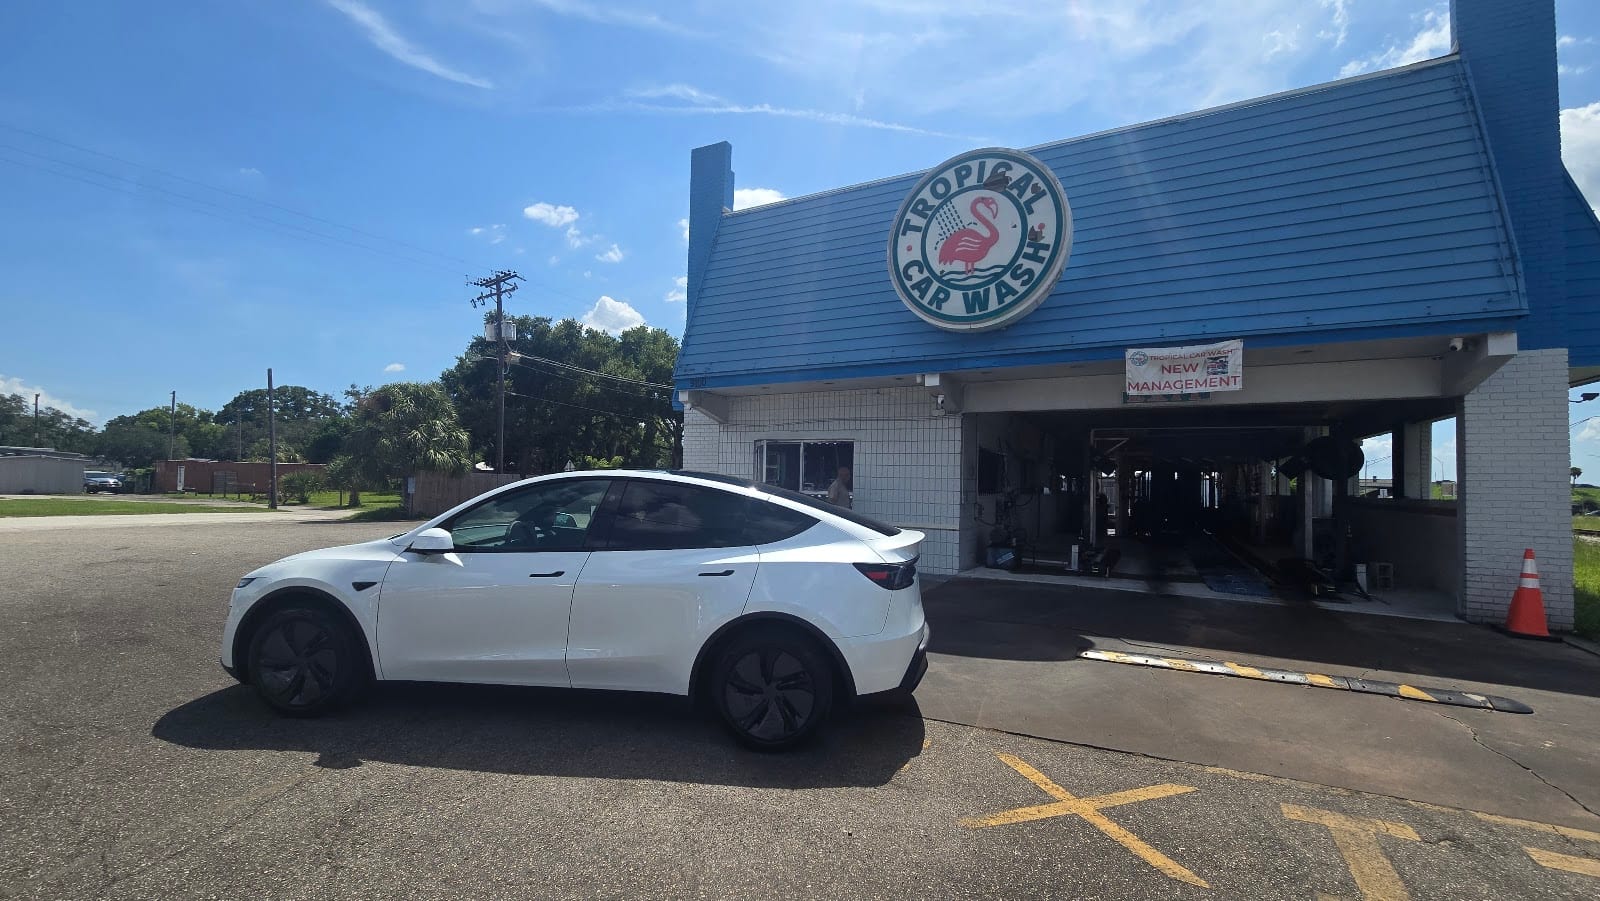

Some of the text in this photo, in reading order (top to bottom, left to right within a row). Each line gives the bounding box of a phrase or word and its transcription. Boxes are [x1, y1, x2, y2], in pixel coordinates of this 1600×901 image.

[901, 161, 1047, 236] TROPICAL
[903, 241, 1050, 314] CAR WASH
[1189, 351, 1206, 359] CAR
[1207, 349, 1233, 357] WASH
[1161, 363, 1198, 374] NEW
[1128, 376, 1240, 391] MANAGEMENT
